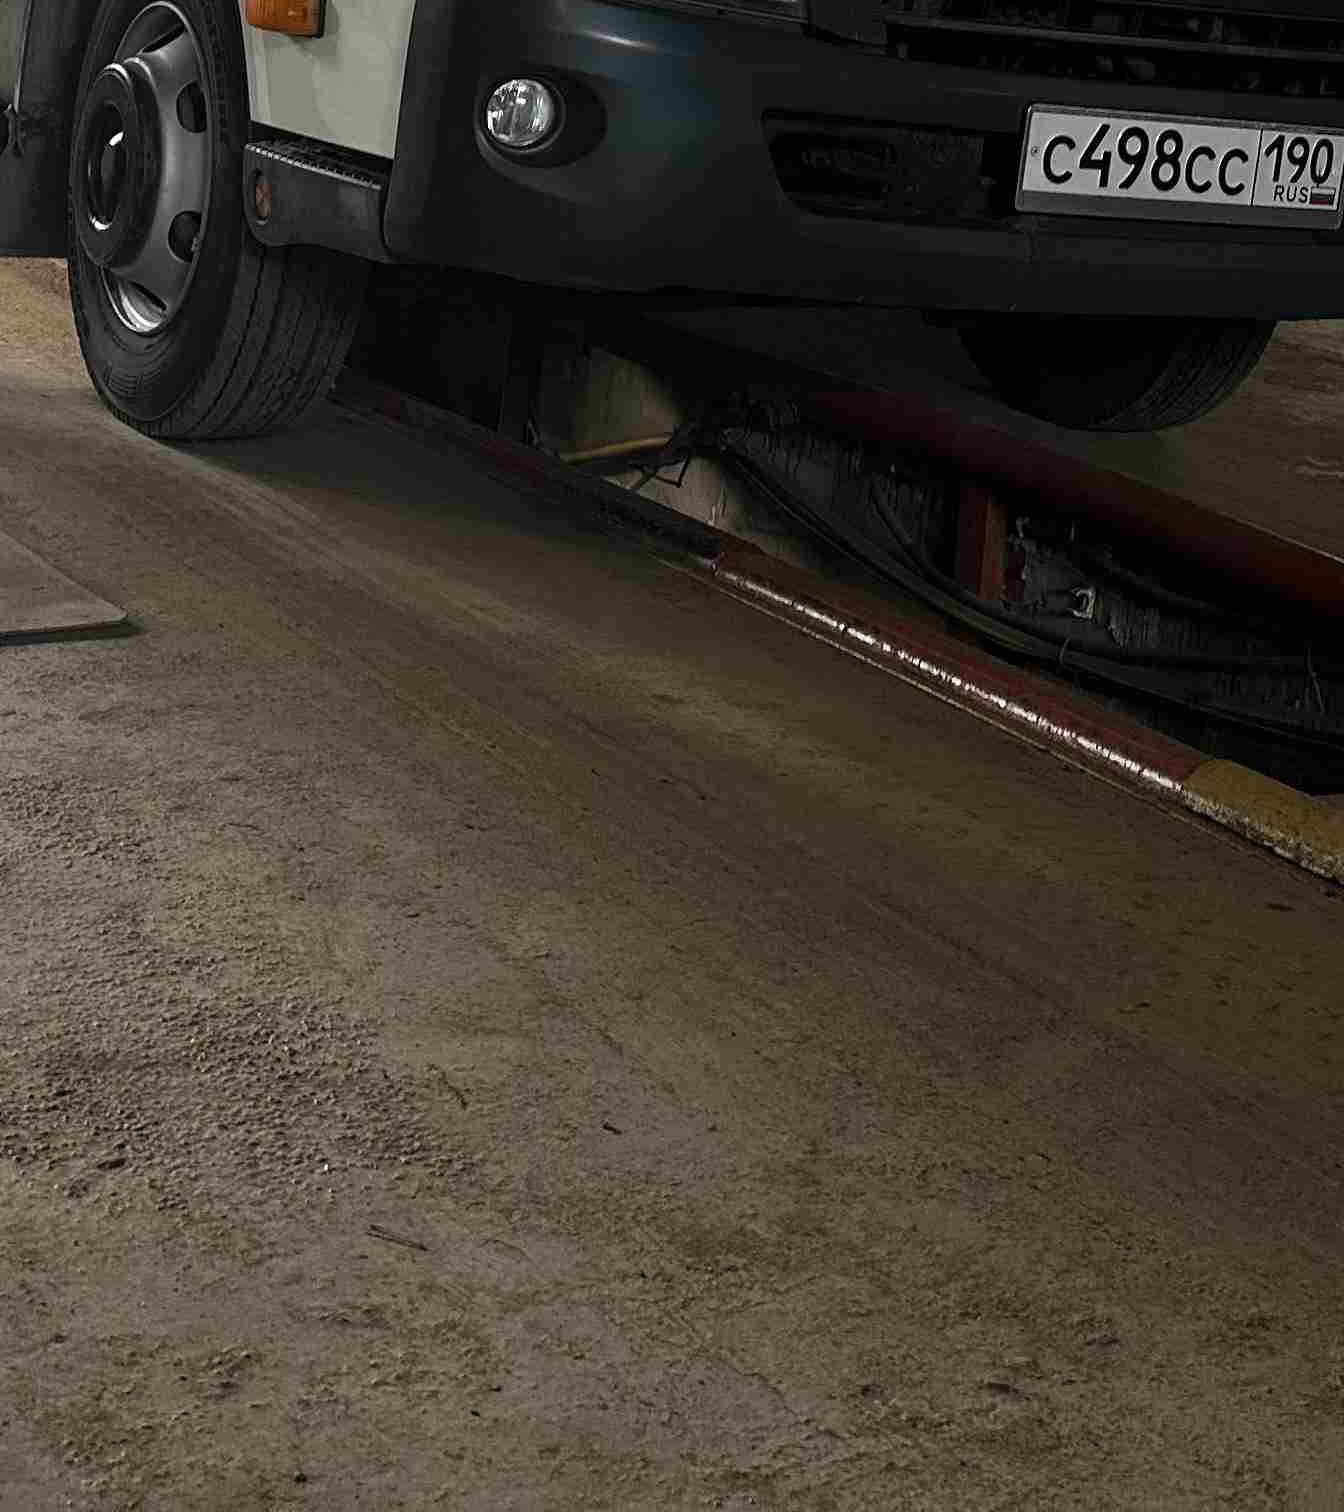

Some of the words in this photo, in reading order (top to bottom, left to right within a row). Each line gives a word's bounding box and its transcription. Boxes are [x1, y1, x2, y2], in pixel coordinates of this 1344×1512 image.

[1042, 123, 1250, 197] С498СС
[1263, 134, 1335, 186] 190
[1272, 184, 1309, 204] RUS
